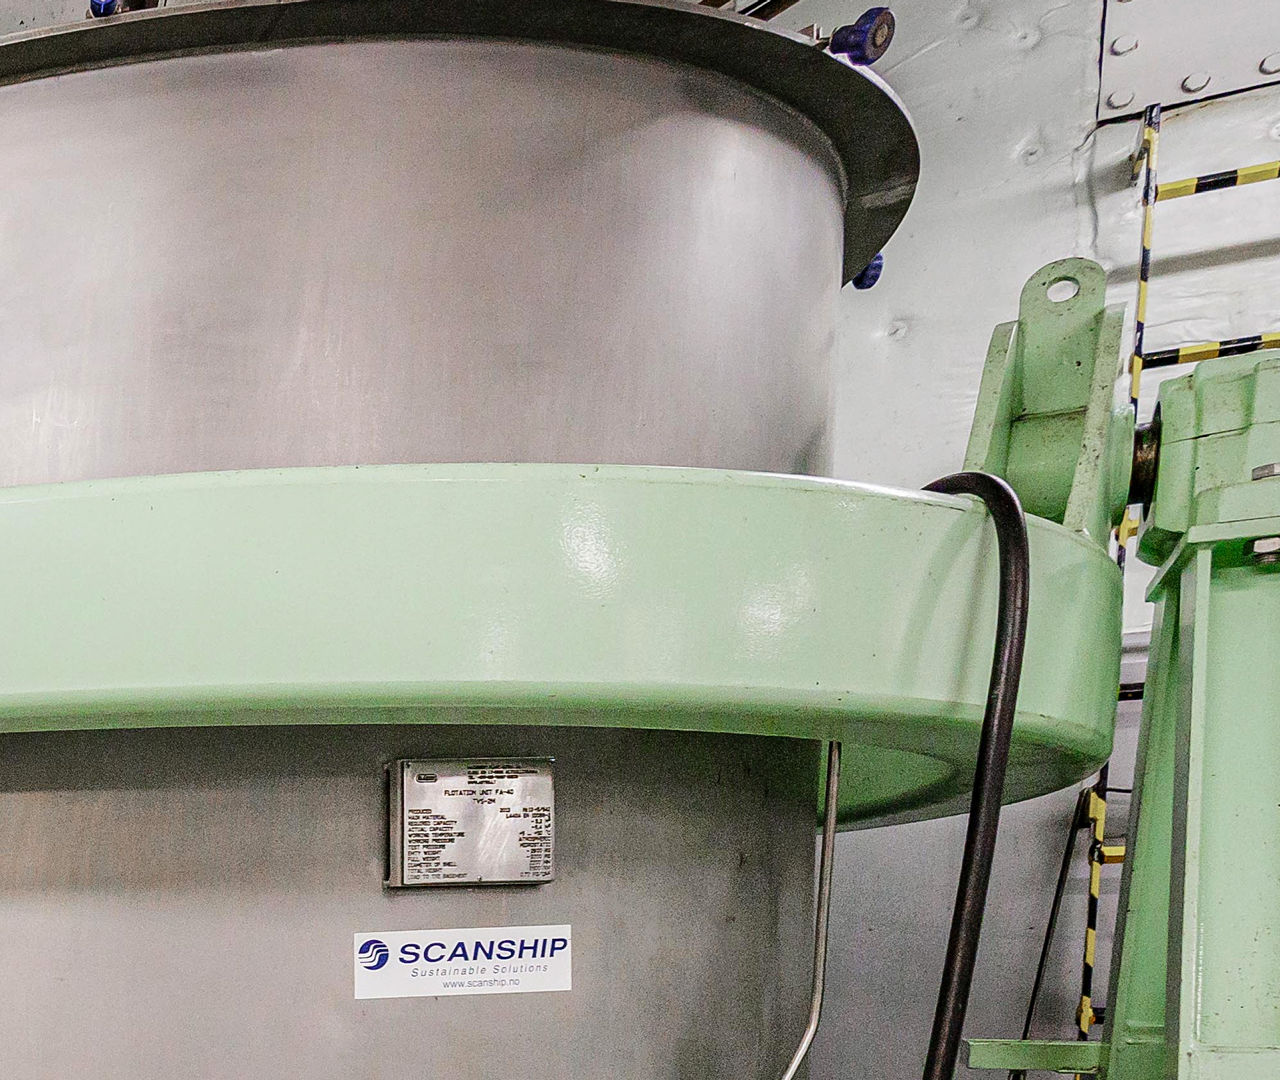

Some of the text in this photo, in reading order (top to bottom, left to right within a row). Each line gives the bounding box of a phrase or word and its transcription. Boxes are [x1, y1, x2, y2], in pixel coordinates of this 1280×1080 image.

[398, 938, 568, 964] SCANSHIP
[410, 963, 549, 978] Sustainable Solutions
[442, 978, 521, 990] www.scanship.no
